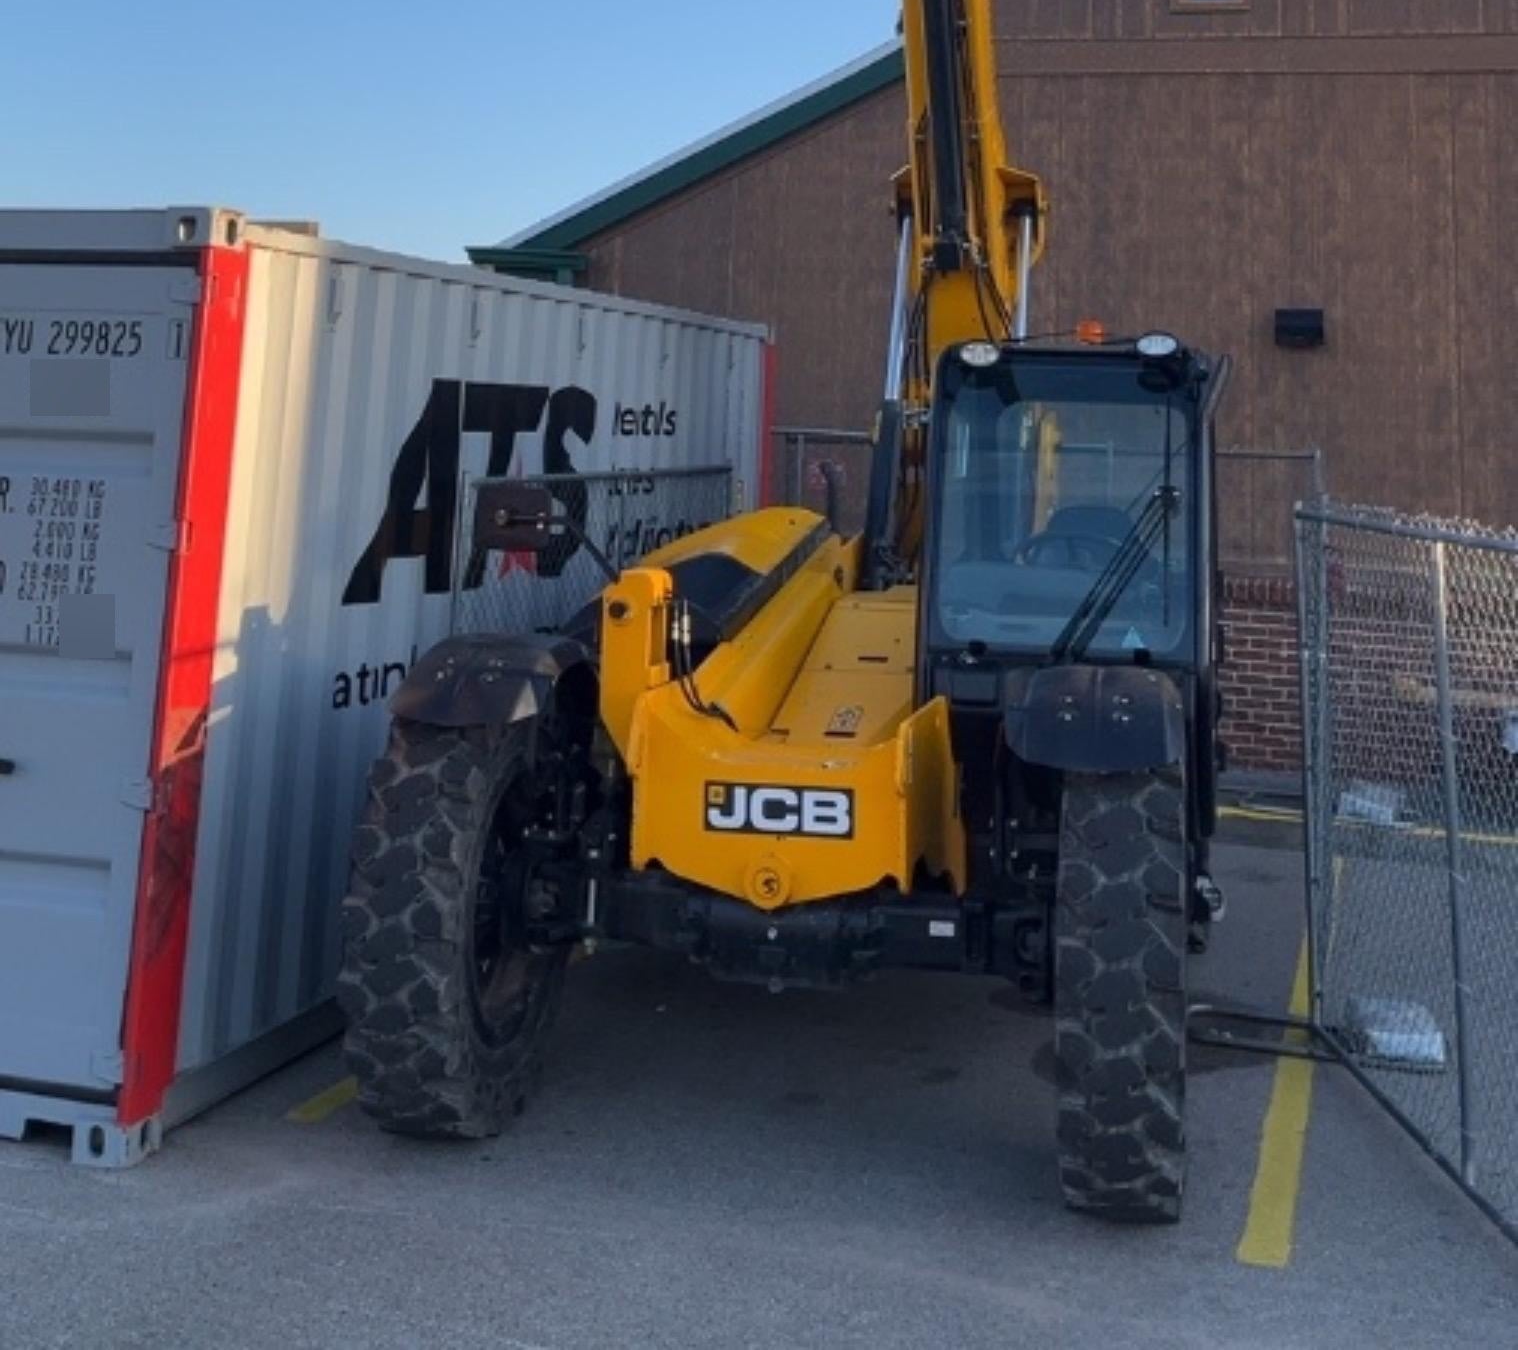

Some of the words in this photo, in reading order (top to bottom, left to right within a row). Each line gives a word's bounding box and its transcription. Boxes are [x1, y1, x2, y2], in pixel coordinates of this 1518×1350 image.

[0, 318, 34, 355] YU
[47, 320, 142, 356] 299825
[88, 480, 105, 499] KG
[342, 378, 598, 606] ATS
[86, 500, 101, 520] LB
[82, 522, 99, 540] KG
[80, 542, 96, 561] LB
[706, 786, 851, 834] JCB
